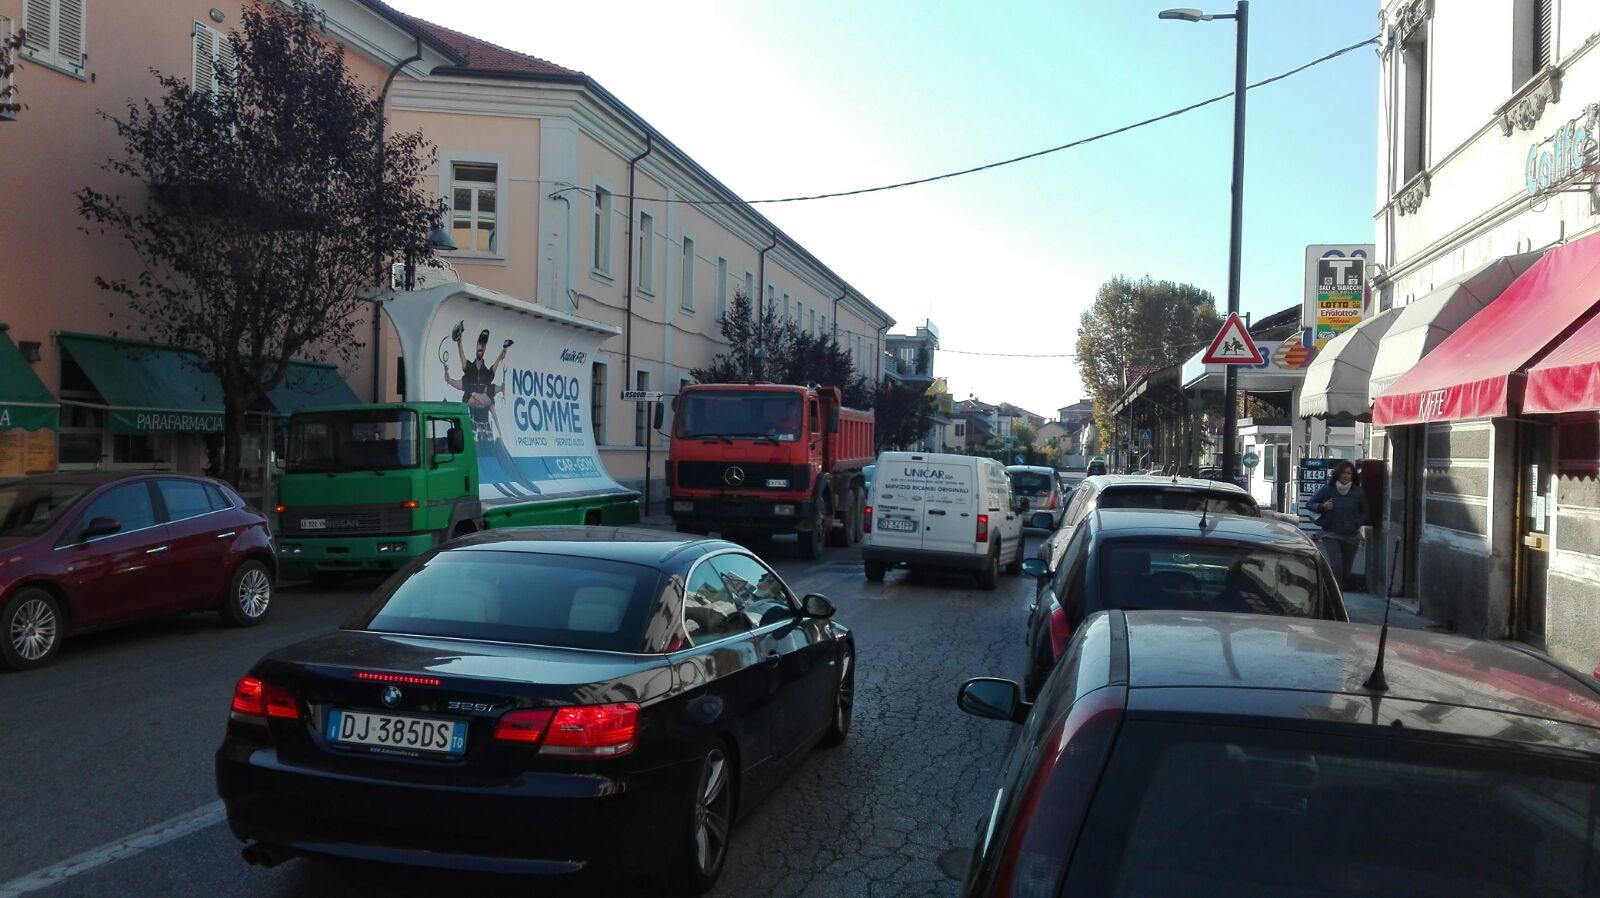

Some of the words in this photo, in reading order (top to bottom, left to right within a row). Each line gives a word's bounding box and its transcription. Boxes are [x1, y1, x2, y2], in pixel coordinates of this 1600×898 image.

[1320, 301, 1349, 309] LOTTO
[512, 367, 544, 397] NON
[545, 373, 579, 402] SOLO
[136, 413, 225, 431] PARAFARMACIA
[514, 397, 582, 434] GOMME
[904, 467, 945, 479] UNICAR
[885, 482, 911, 491] SERVIZIO
[937, 486, 969, 494] ORIGINALI
[447, 701, 494, 712] 325i
[342, 714, 371, 741] DJ
[377, 718, 450, 749] 385DS
